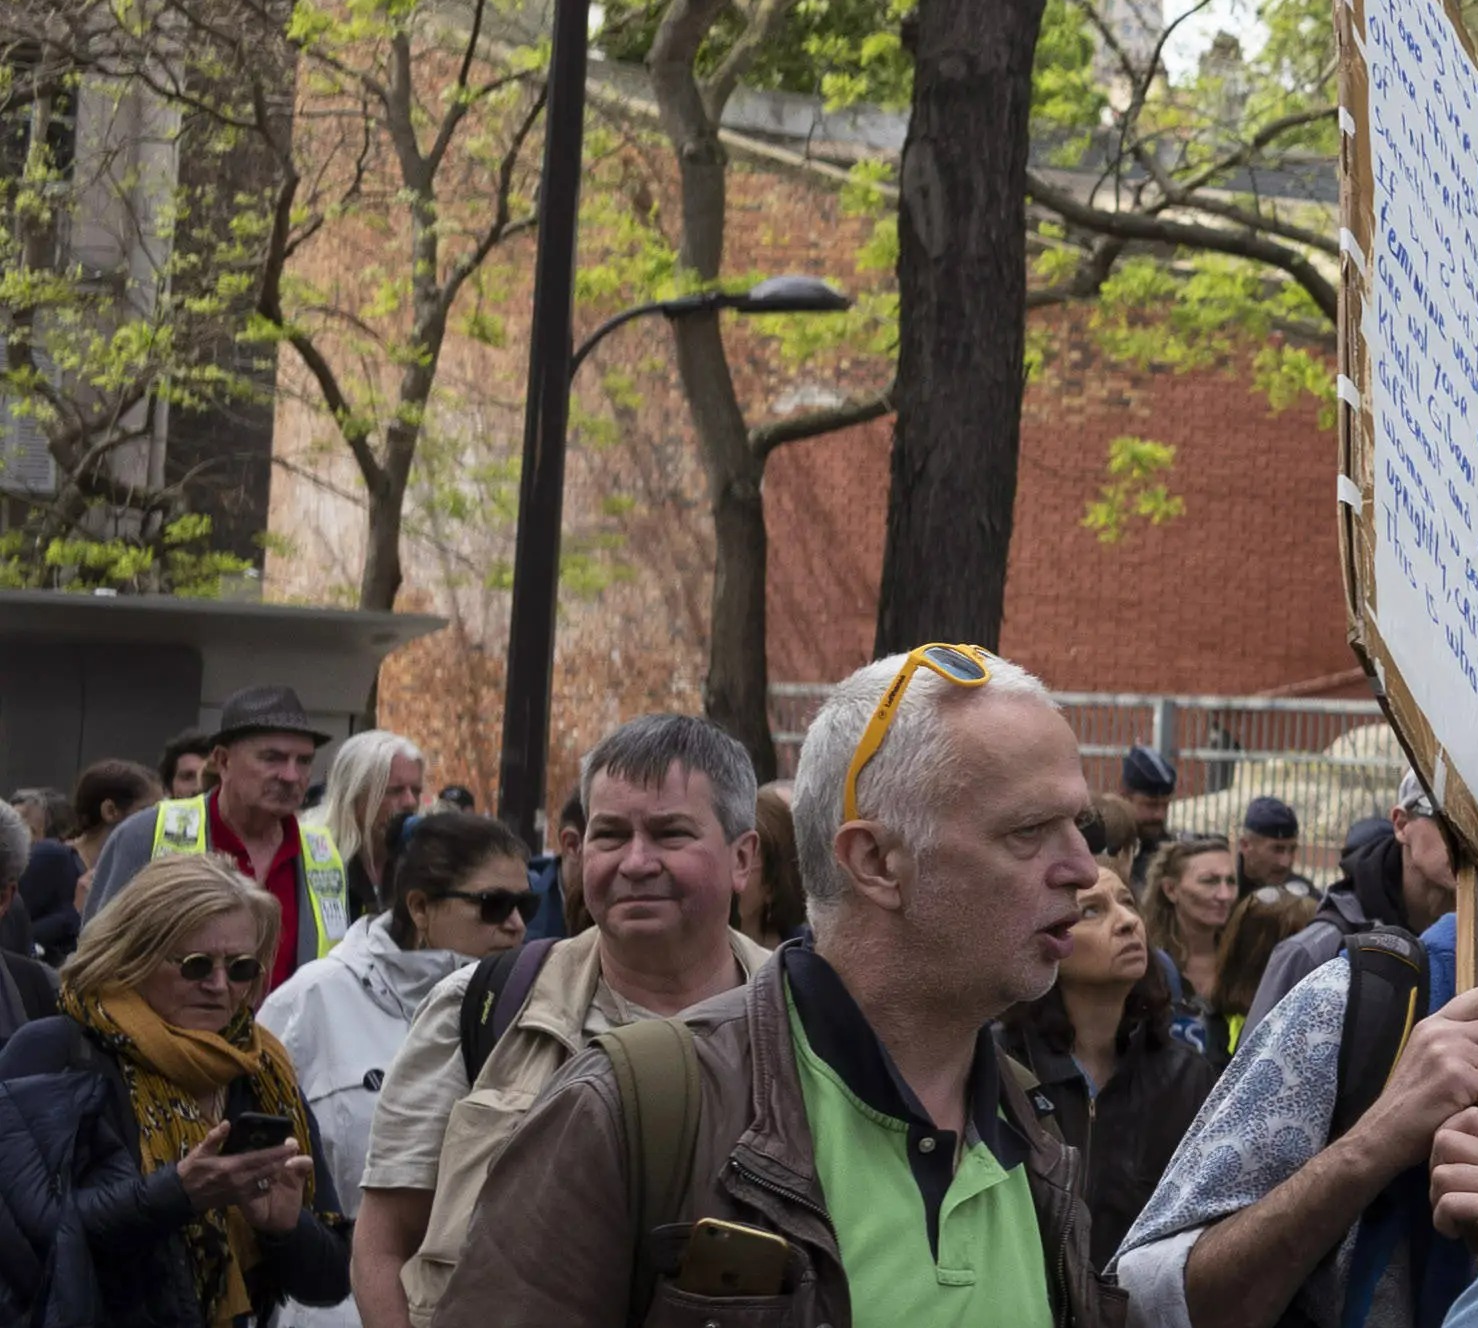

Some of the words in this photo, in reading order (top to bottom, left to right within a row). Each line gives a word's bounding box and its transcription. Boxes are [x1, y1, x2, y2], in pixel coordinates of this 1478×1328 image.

[1377, 156, 1397, 201] If
[1408, 205, 1429, 277] by
[1379, 294, 1421, 404] Khalil
[1433, 357, 1468, 424] your
[1379, 352, 1443, 476] different
[1383, 503, 1417, 589] This
[1425, 583, 1439, 625] is
